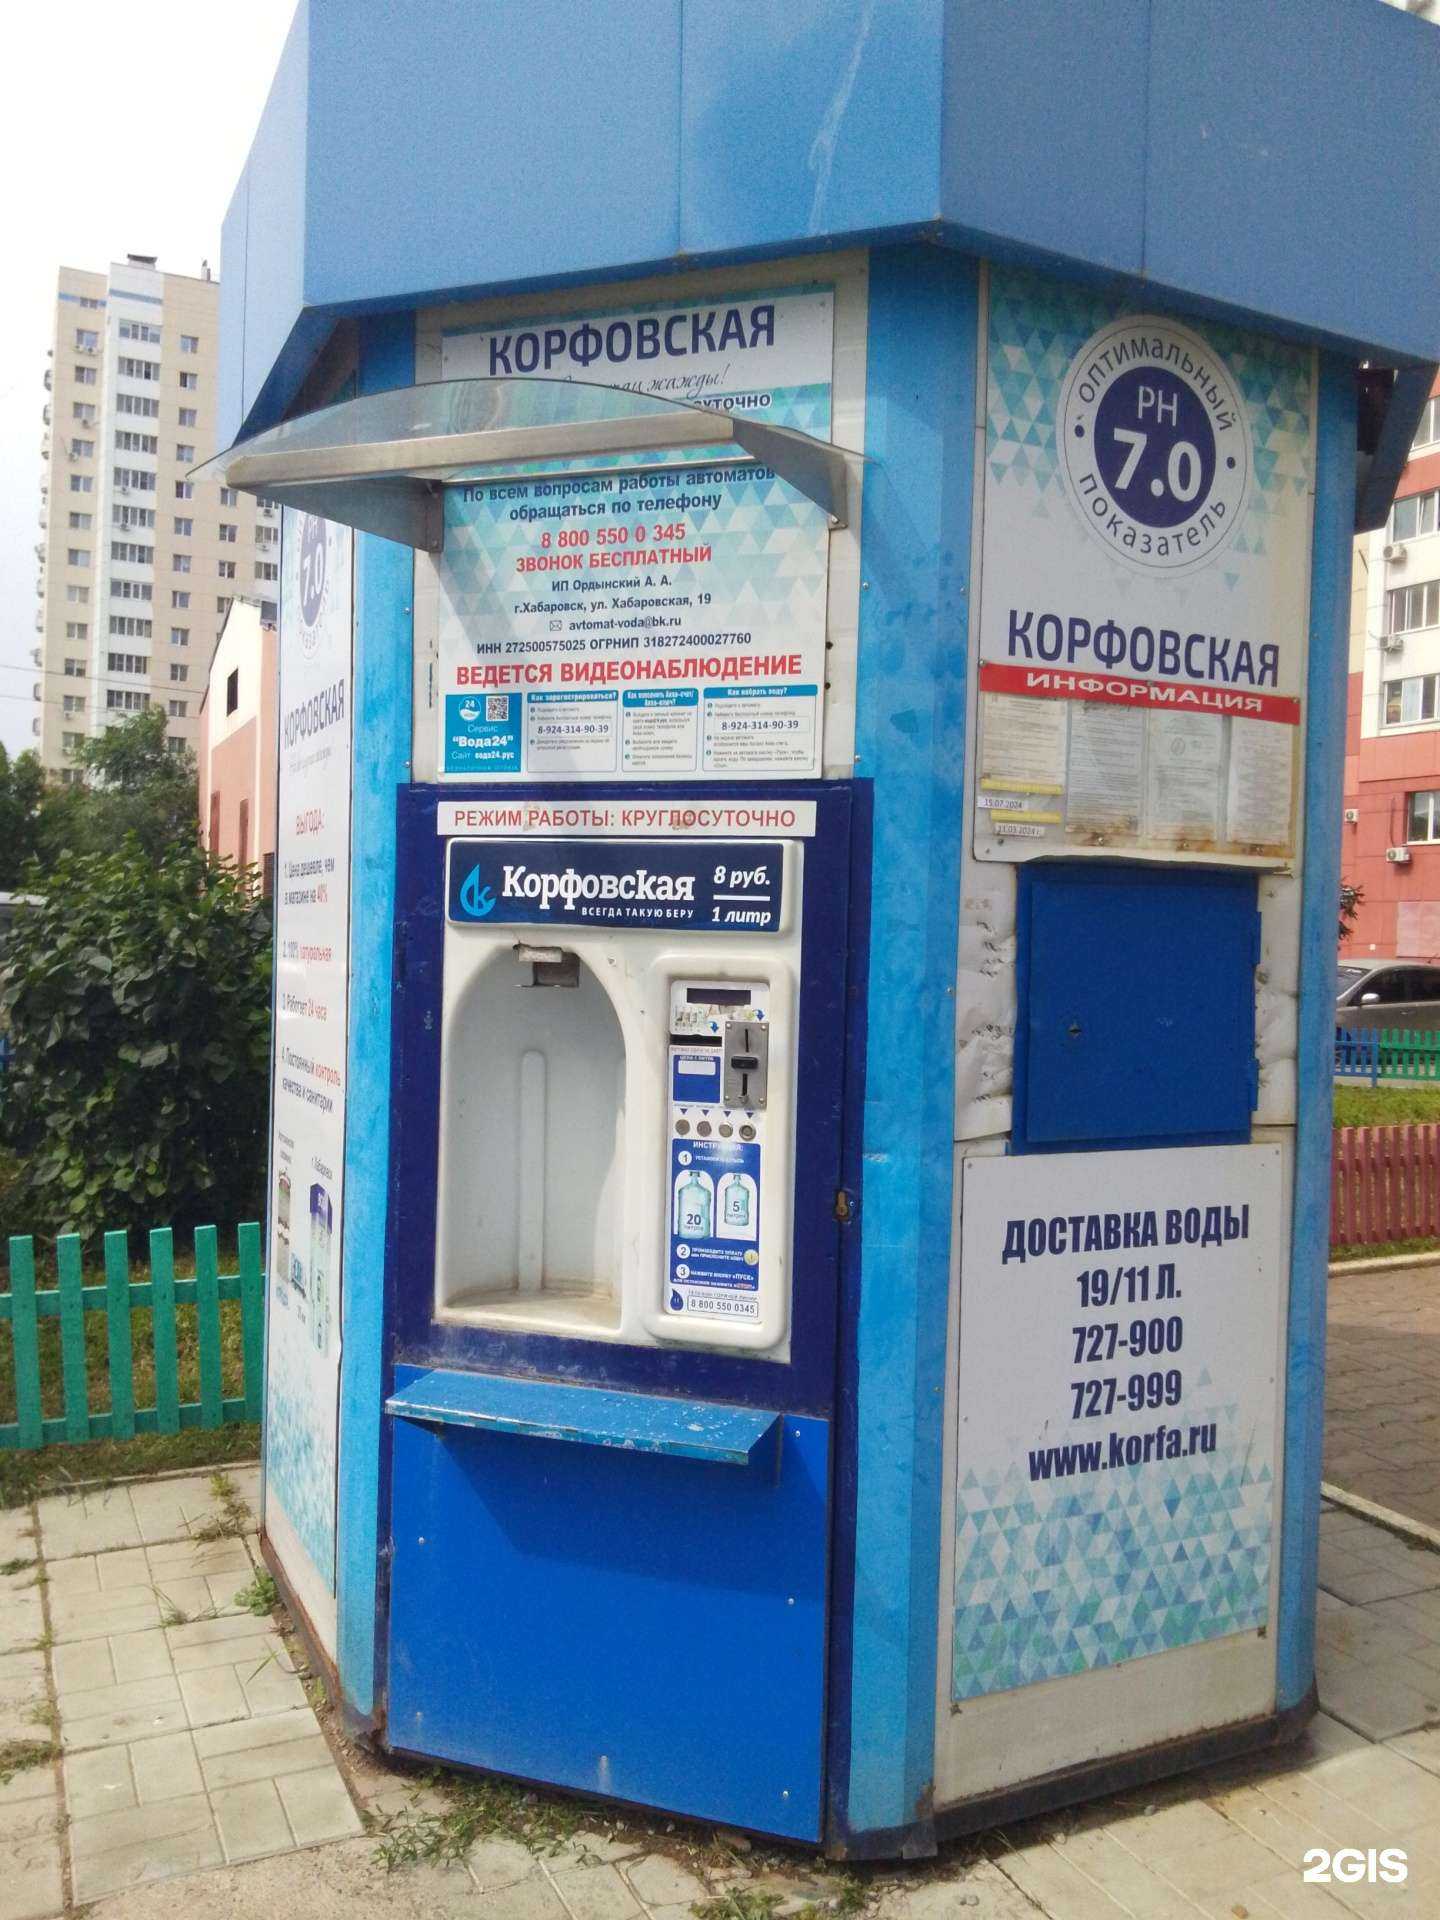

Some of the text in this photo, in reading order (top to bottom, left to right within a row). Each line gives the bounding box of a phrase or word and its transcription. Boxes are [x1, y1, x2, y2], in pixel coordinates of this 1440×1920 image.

[489, 305, 775, 376] КОРФОВСКАЯ
[646, 363, 730, 399] жажды!
[1114, 427, 1202, 502] 7.0
[463, 466, 776, 502] По всем вопросам работы автоматов
[510, 494, 722, 523] обращаться по телефону
[541, 523, 686, 548] 8 800 550 0 345
[516, 543, 713, 573] ЗВОНОК БЕСПЛАТНЫЙ
[552, 575, 672, 593] ИП Ордынский А. А.
[514, 593, 712, 615] г.Хабаровск, ул. Хабаровская, 19
[569, 616, 682, 632] avtomat-voda@bk.ru
[477, 633, 752, 655] ИНН 272500575025 ОГРНИП 318272400027760
[1008, 609, 1280, 688] КОРФОВСКАЯ
[457, 654, 803, 688] ВЕДЕТСЯ ВИДЕОНАБЛЮДЕНИЕ
[465, 699, 475, 709] 24
[1026, 672, 1264, 712] ИНФОРМАЦИЯ
[284, 679, 344, 750] КОРФОВСКАЯ
[721, 720, 798, 731] 8-924-314-90-39
[537, 724, 609, 735] 8-924-314-90-39
[454, 809, 796, 827] РЕЖИМ РАБОТЫ: КРУГЛОСУТОЧНО
[502, 865, 696, 911] Корфовская
[714, 865, 771, 887] 8 руб.
[582, 906, 694, 919] ВСЕГДА ТАКУЮ БЕРУ
[712, 907, 771, 926] 1 литр
[733, 1201, 740, 1212] 5
[686, 1214, 702, 1226] 20
[1002, 1204, 1249, 1265] ДОСТАВКА ВОДЫ
[680, 1246, 687, 1256] 2
[680, 1266, 686, 1276] 3
[1077, 1263, 1182, 1308] 19/11 Л.
[691, 1300, 755, 1314] 8 800 550 0345
[1072, 1315, 1183, 1364] 727-900
[1071, 1369, 1182, 1420] 727-999
[1028, 1423, 1217, 1481] www.korfa.ru
